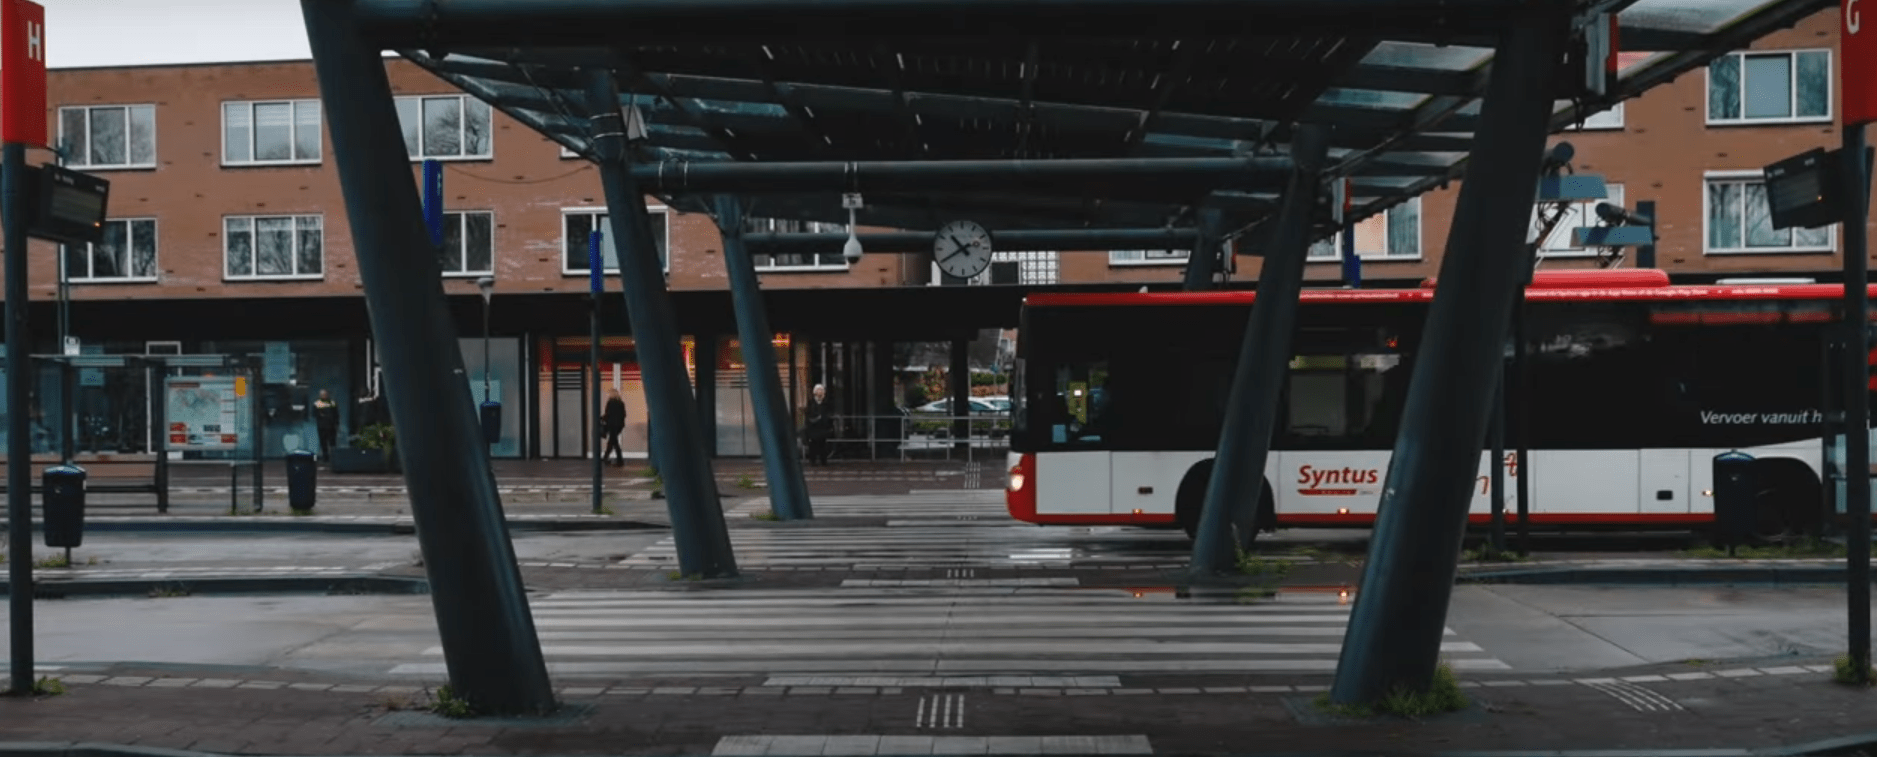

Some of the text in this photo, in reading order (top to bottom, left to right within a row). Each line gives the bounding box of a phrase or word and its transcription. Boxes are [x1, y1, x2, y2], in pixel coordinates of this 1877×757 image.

[1846, 0, 1860, 34] G
[27, 20, 41, 62] H
[1701, 410, 1757, 424] Vervoer
[1761, 410, 1808, 424] vanuit
[1298, 465, 1378, 488] Syntus
